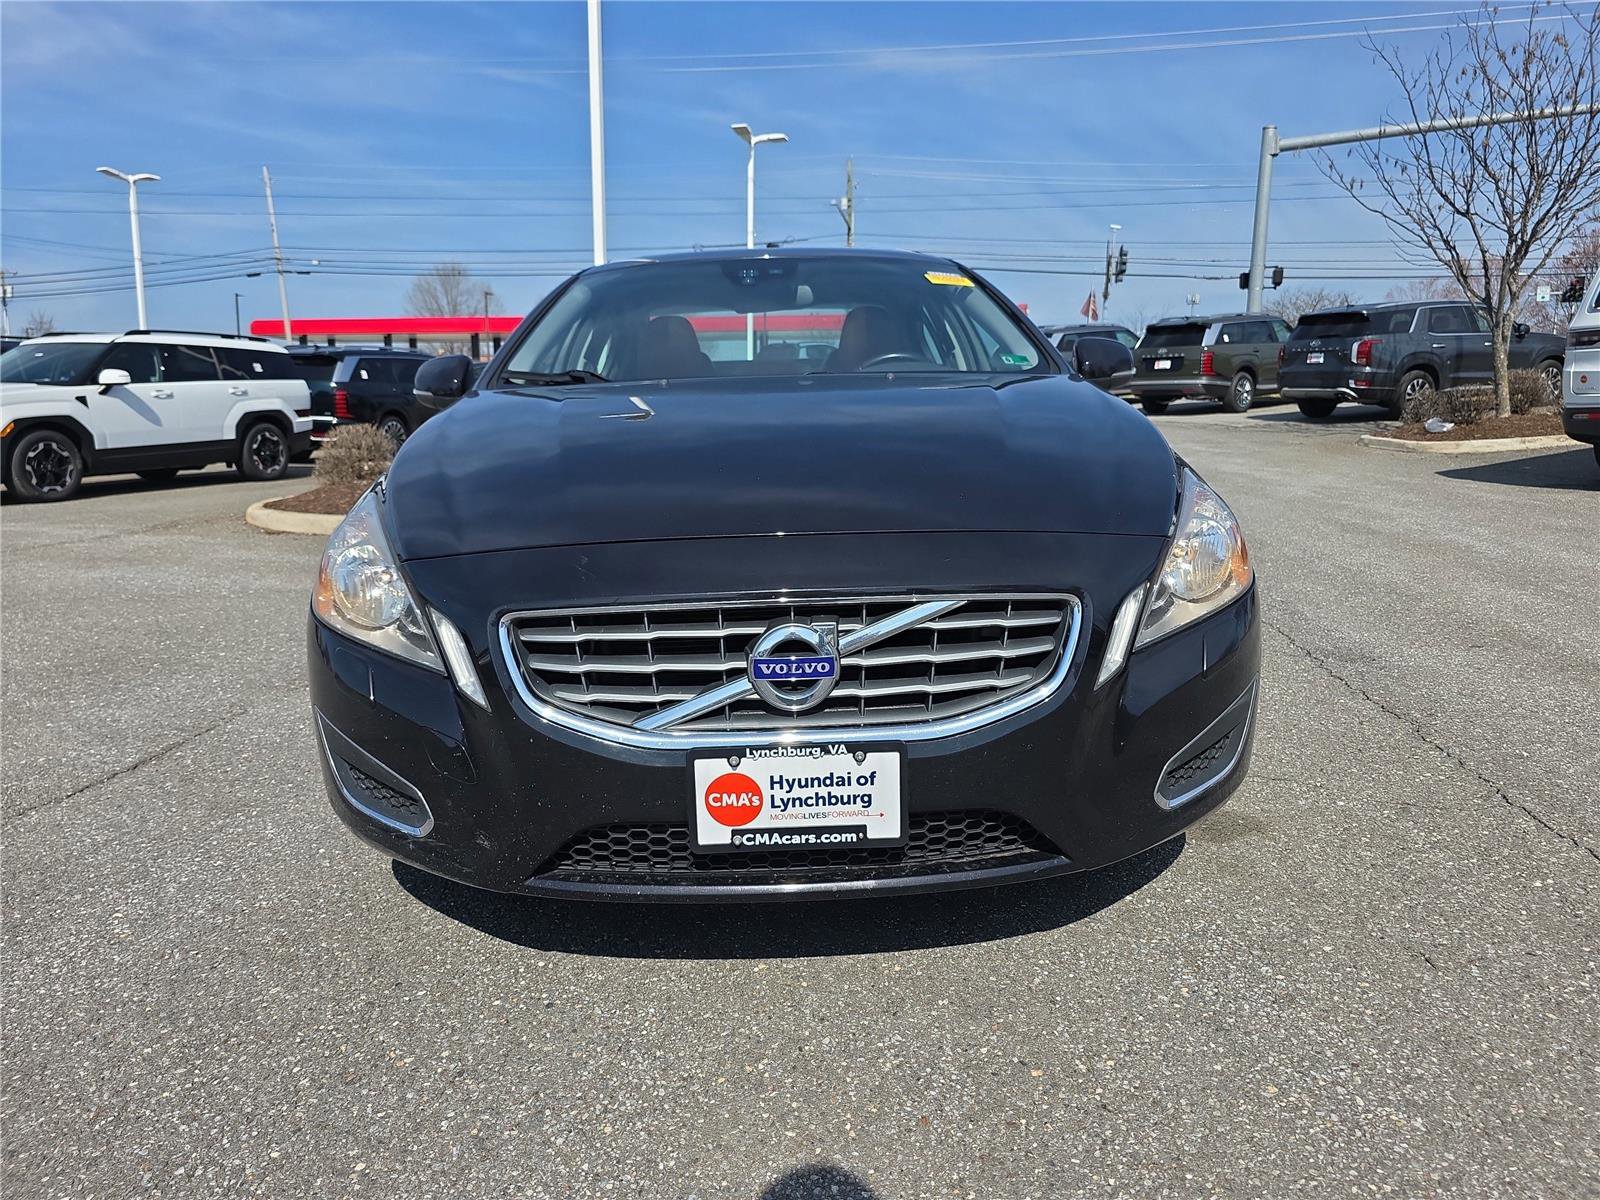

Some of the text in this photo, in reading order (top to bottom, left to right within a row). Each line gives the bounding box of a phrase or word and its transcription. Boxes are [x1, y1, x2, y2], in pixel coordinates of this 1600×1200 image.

[757, 662, 830, 675] VOLVO
[745, 744, 848, 761] Lynchburg, VA
[769, 770, 877, 794] Hyundai of
[708, 792, 761, 808] CMA's
[770, 791, 873, 812] Lynchburg
[742, 832, 857, 846] CMAcars.com
